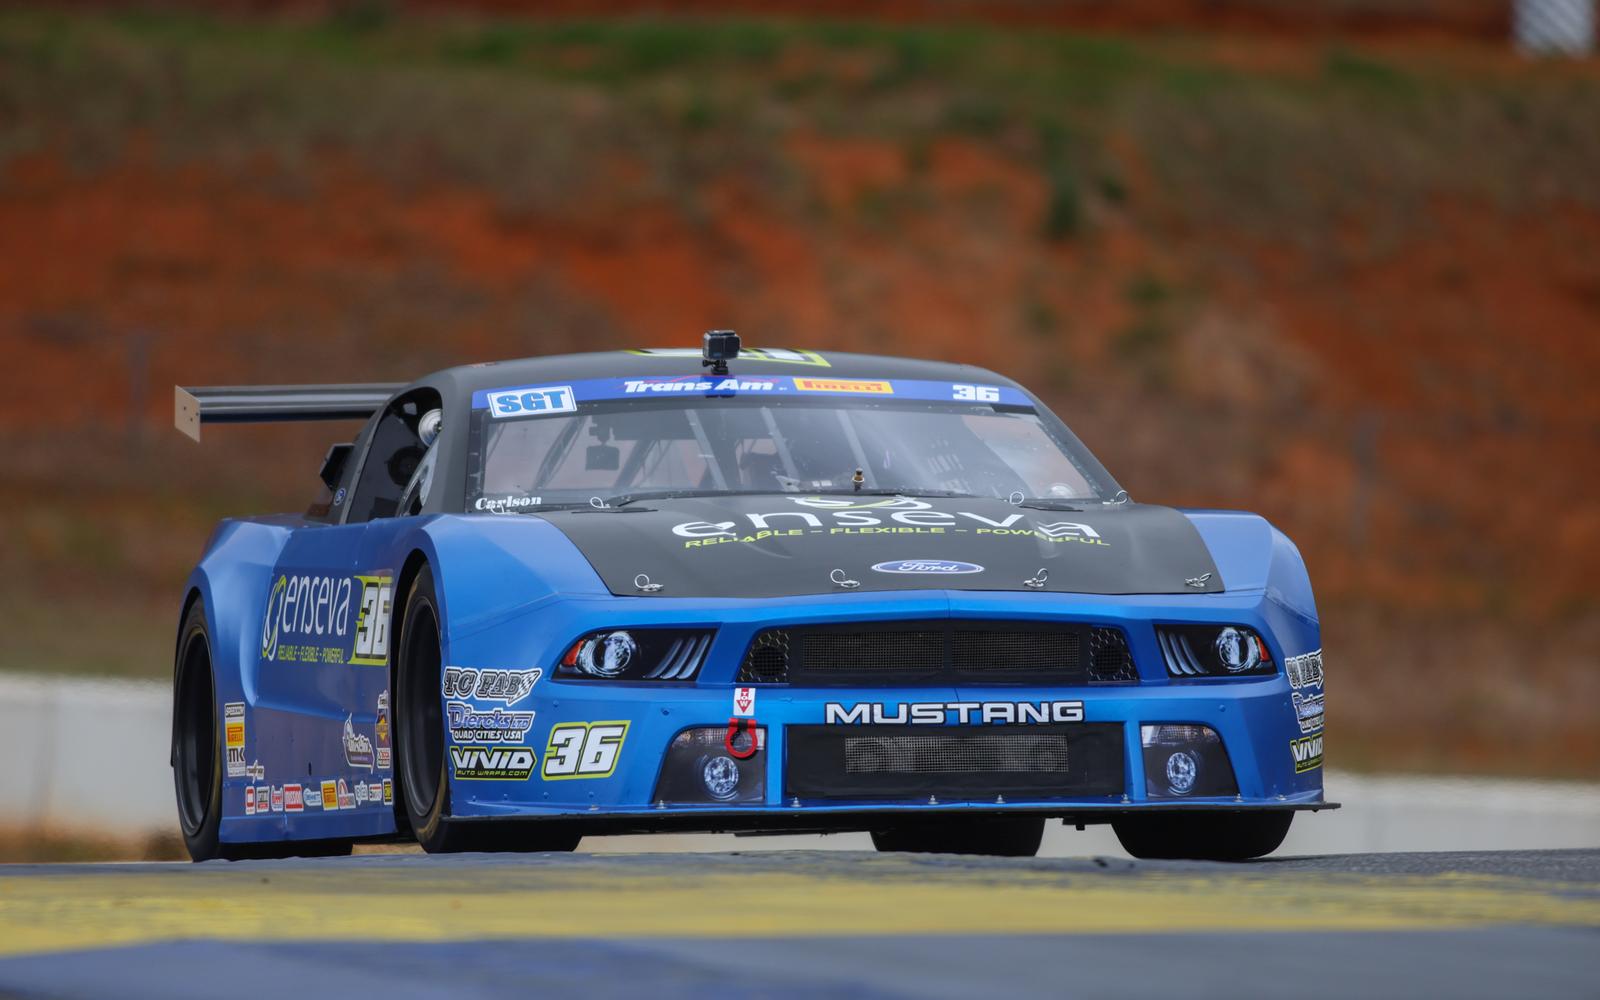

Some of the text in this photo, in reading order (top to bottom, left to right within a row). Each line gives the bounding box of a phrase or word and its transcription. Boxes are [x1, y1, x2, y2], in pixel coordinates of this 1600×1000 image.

[623, 377, 773, 393] Trans Am
[952, 384, 999, 402] 36
[496, 390, 565, 413] SGT
[475, 495, 542, 511] Carlson
[671, 510, 1101, 538] enseva
[685, 528, 804, 549] RELIABLE
[830, 527, 945, 535] FLEXIBLE
[976, 527, 1111, 546] POWERFUL
[898, 560, 959, 572] Ford
[283, 575, 352, 636] enseva
[356, 583, 391, 658] 36
[478, 671, 522, 697] FAB
[739, 691, 749, 707] TOW
[448, 705, 531, 729] Diercks LTD
[827, 701, 1084, 724] MUSTANG
[454, 730, 521, 739] QUAD CITIES USA
[544, 724, 626, 777] 36
